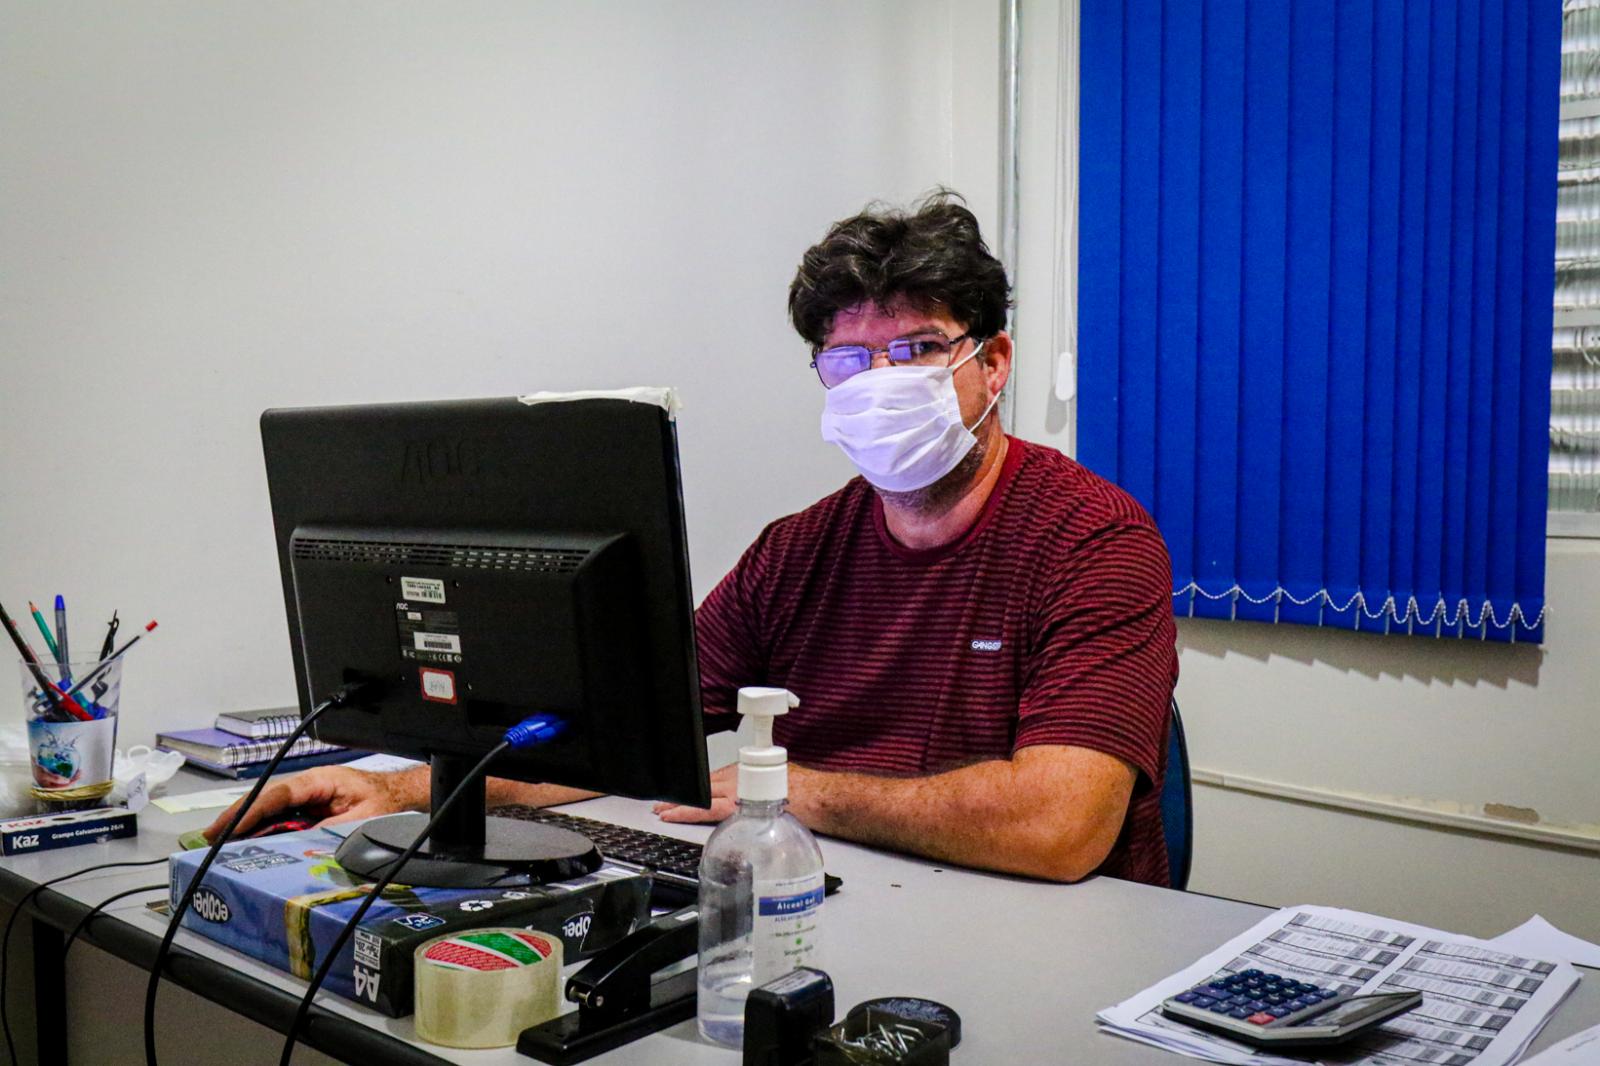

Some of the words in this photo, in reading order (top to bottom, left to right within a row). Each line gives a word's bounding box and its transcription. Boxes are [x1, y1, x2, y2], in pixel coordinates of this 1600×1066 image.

[51, 831, 75, 840] Grampo
[75, 825, 109, 836] Galvanizado
[12, 834, 40, 850] Kaz
[353, 963, 381, 1003] A4
